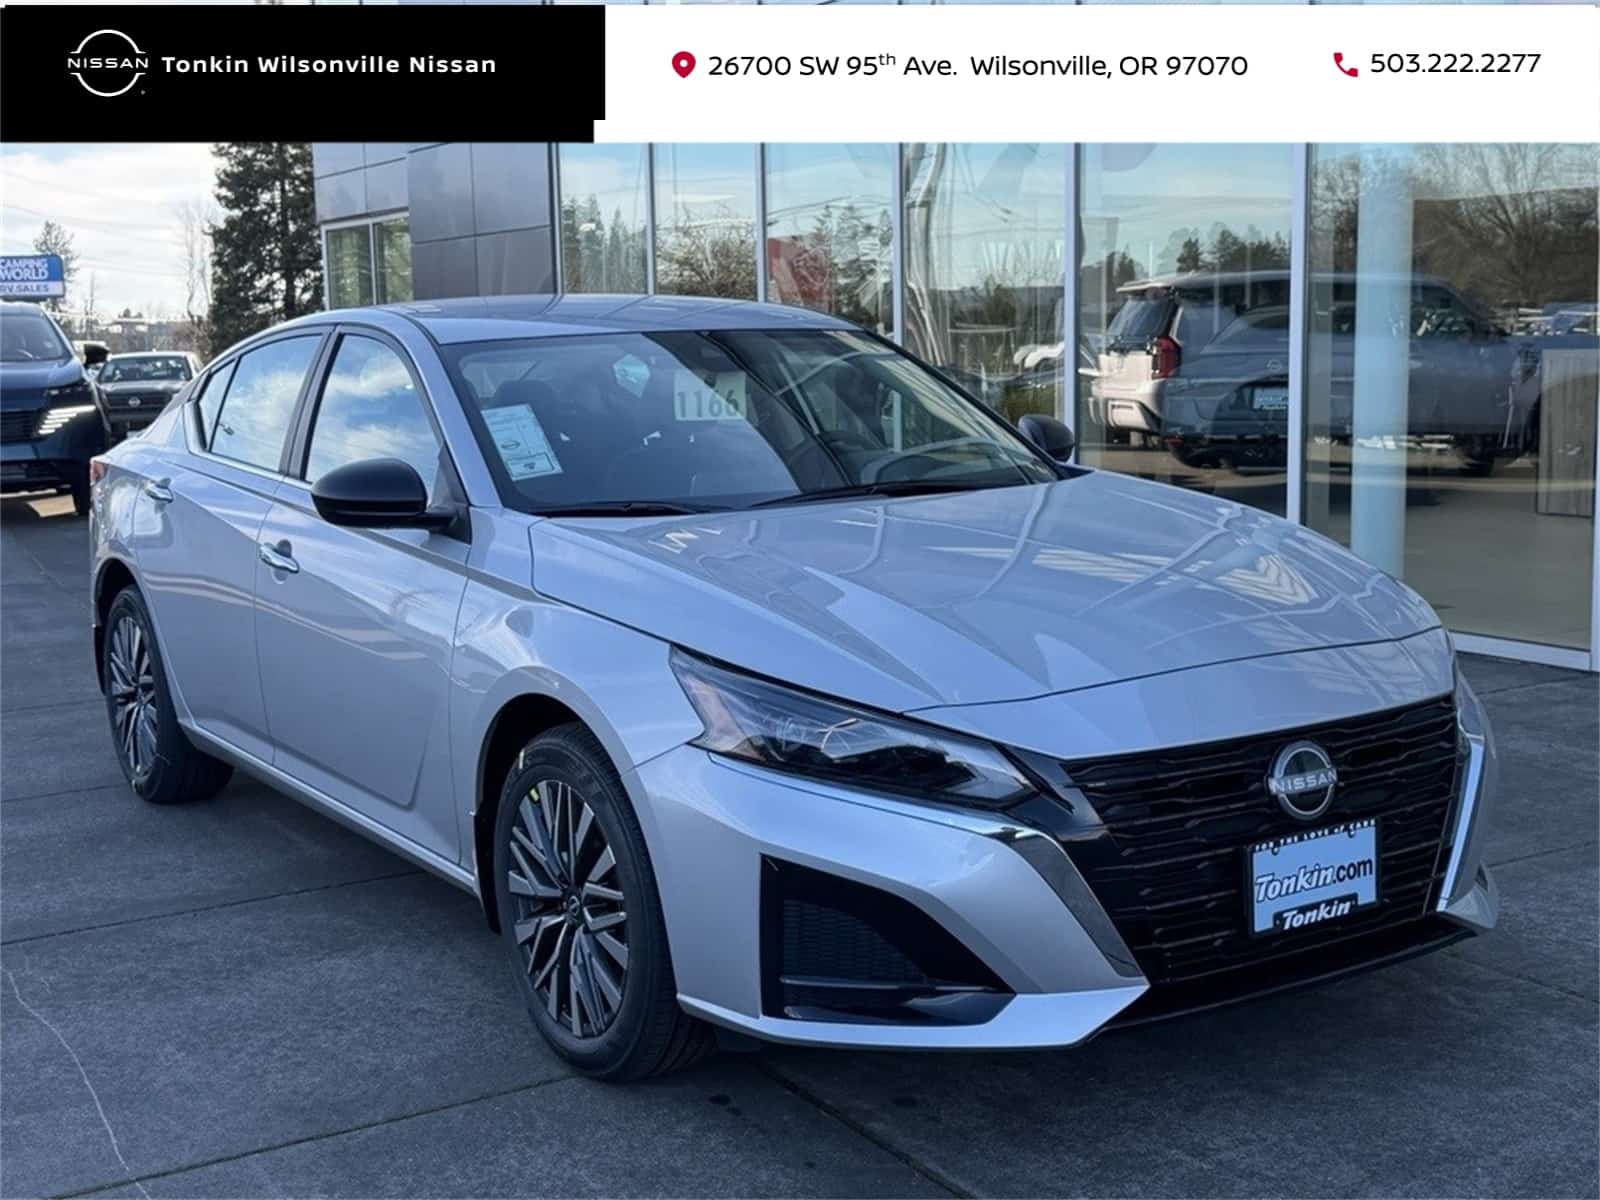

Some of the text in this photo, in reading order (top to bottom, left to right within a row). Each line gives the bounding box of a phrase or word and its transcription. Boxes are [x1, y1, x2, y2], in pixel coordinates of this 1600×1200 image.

[0, 268, 49, 281] WORLD
[1268, 769, 1337, 793] NISSAN
[1254, 858, 1374, 904] Tonkin.com
[1282, 900, 1351, 931] Tonkin
